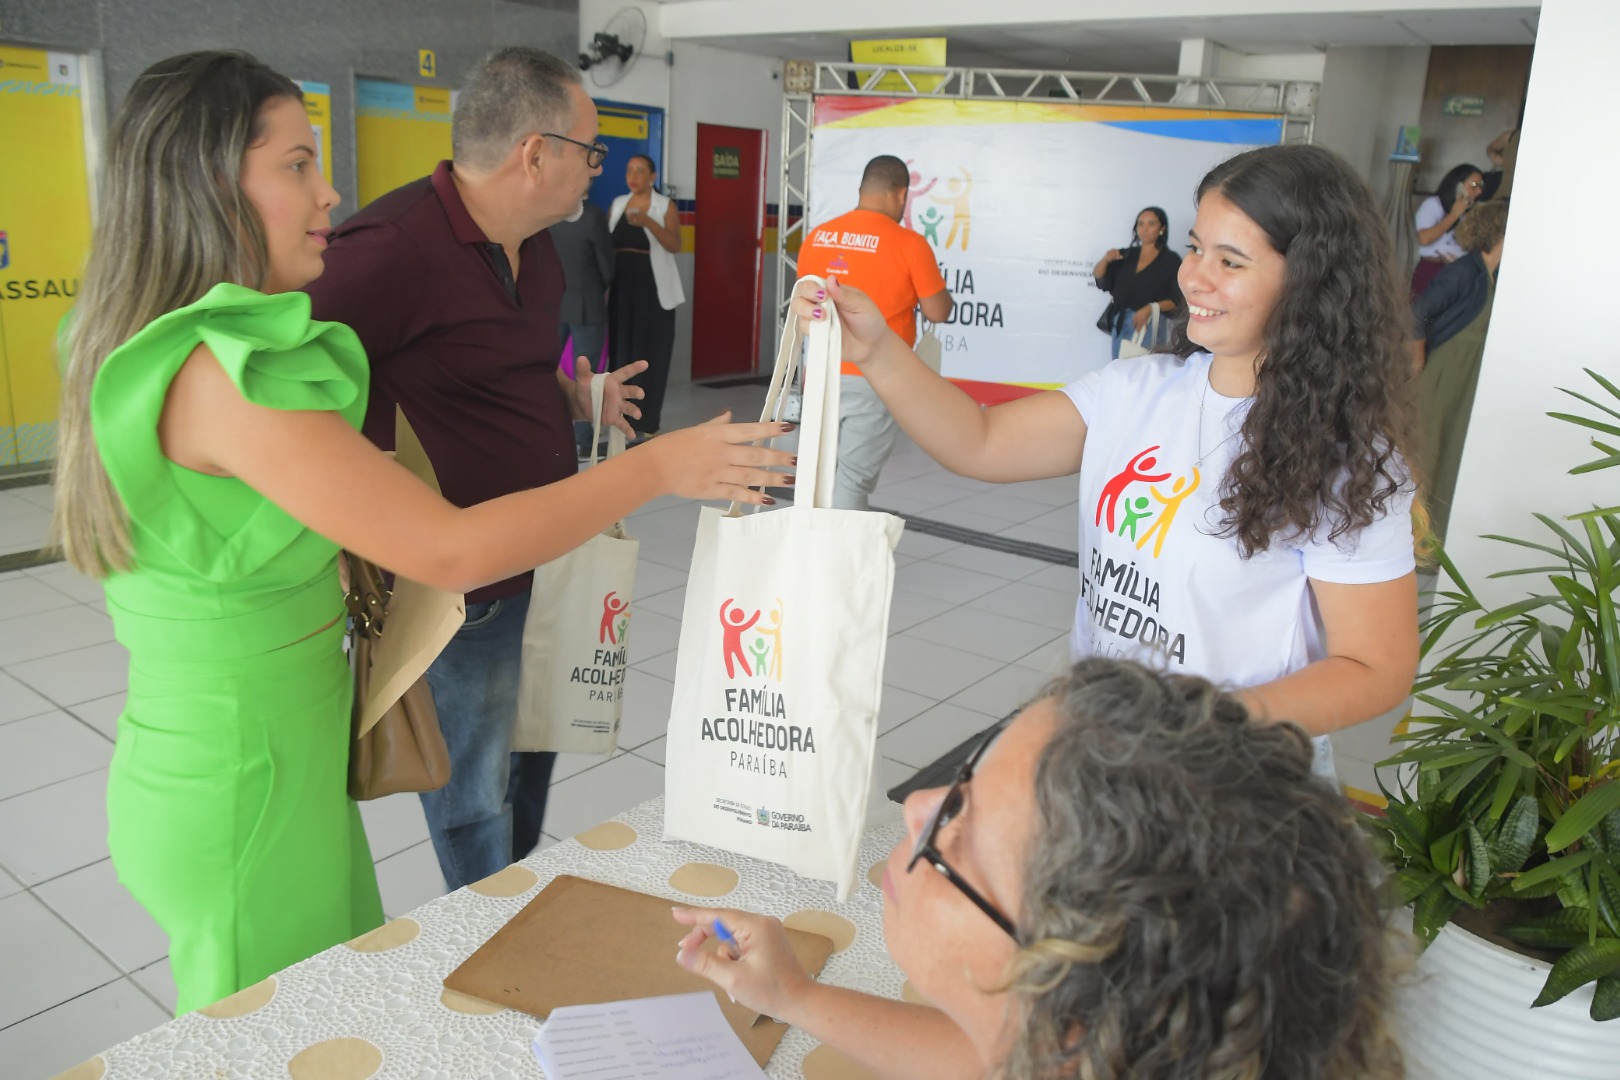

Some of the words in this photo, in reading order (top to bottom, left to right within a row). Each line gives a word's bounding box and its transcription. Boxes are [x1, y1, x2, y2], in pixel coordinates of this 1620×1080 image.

[423, 53, 433, 74] 4
[714, 152, 739, 167] SAÍDA
[841, 232, 879, 249] BONITO
[1091, 547, 1160, 613] FAMÍLIA
[594, 646, 627, 667] FAMÍL
[725, 684, 786, 719] FAMÍLIA
[701, 717, 816, 753] ACOLHEDORA
[730, 751, 787, 778] PARAÍBA
[771, 811, 805, 823] GOVERNO
